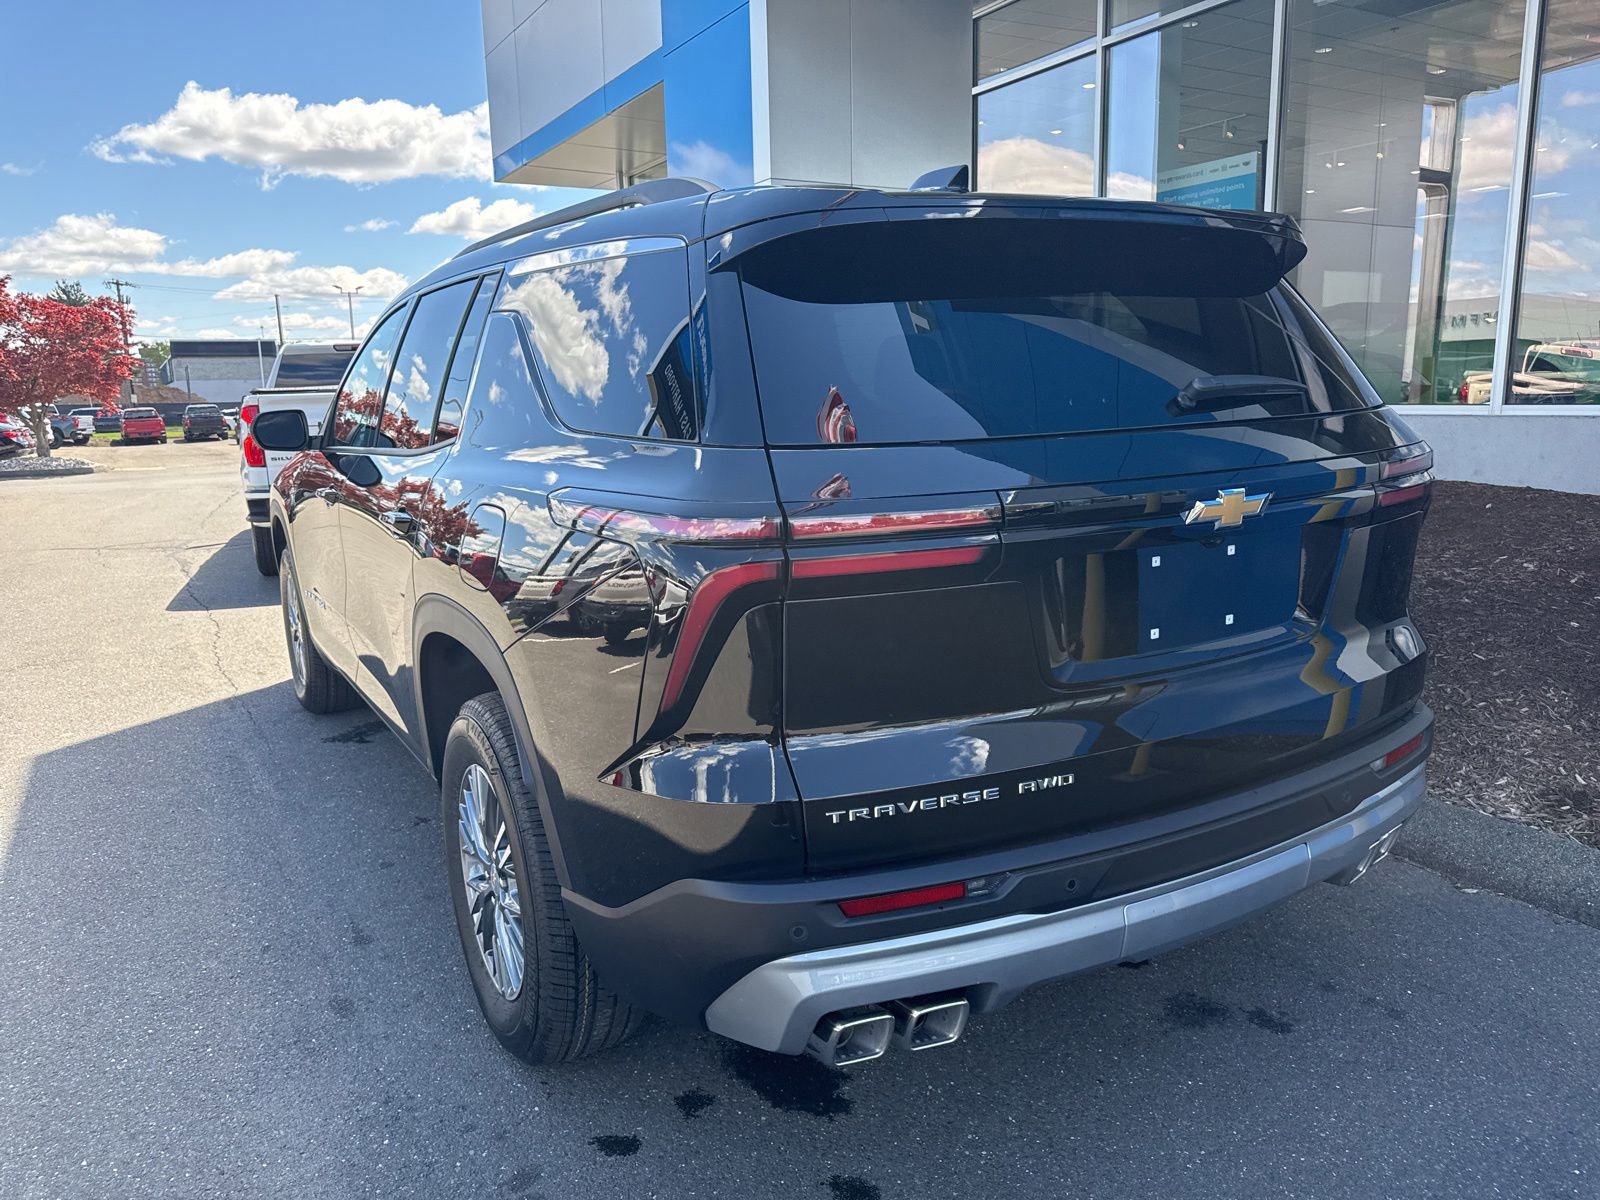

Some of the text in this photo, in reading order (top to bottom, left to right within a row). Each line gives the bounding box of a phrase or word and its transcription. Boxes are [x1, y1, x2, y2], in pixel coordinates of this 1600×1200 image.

[1199, 185, 1225, 196] unlimited
[1226, 182, 1246, 193] points
[825, 773, 1075, 824] TRAVERSE AWD
